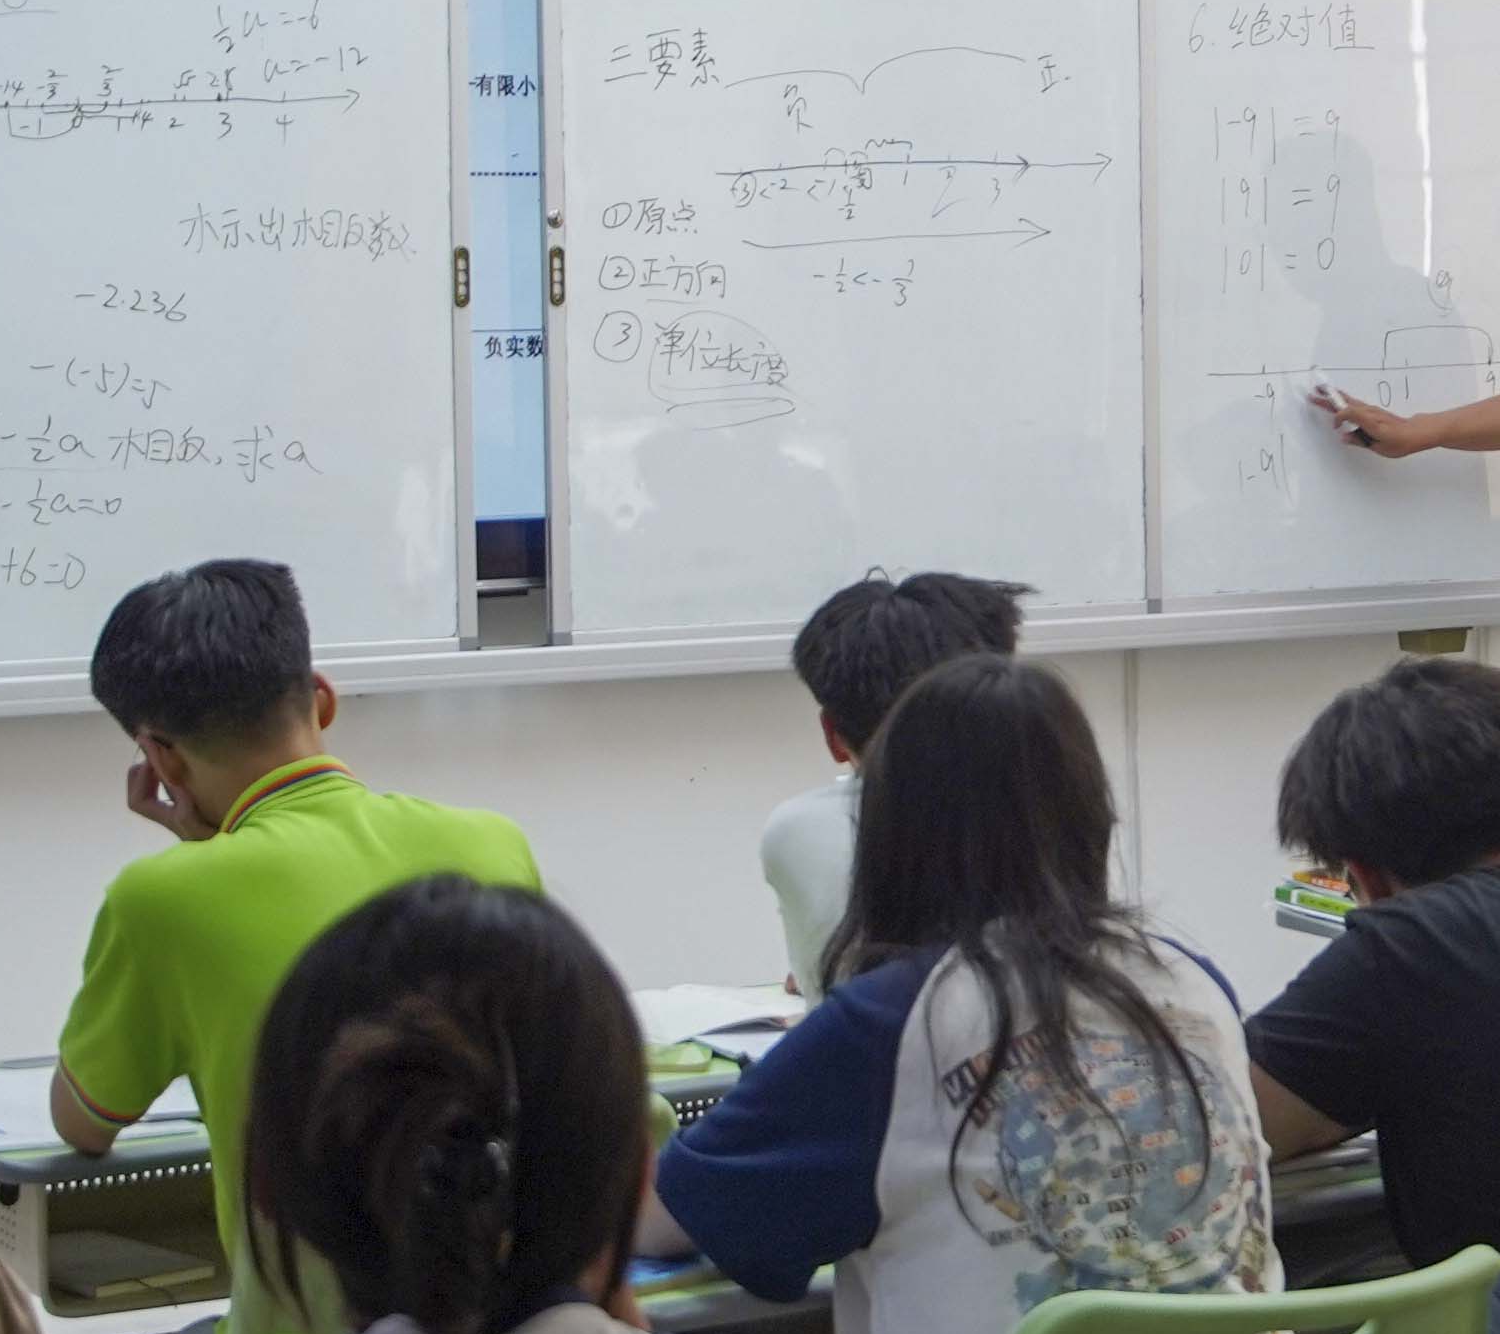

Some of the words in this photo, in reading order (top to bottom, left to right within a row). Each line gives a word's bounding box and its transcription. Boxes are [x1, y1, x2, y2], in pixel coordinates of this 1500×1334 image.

[476, 73, 537, 97] 有限小
[74, 283, 189, 323] -2.236
[484, 334, 544, 362] 负实数
